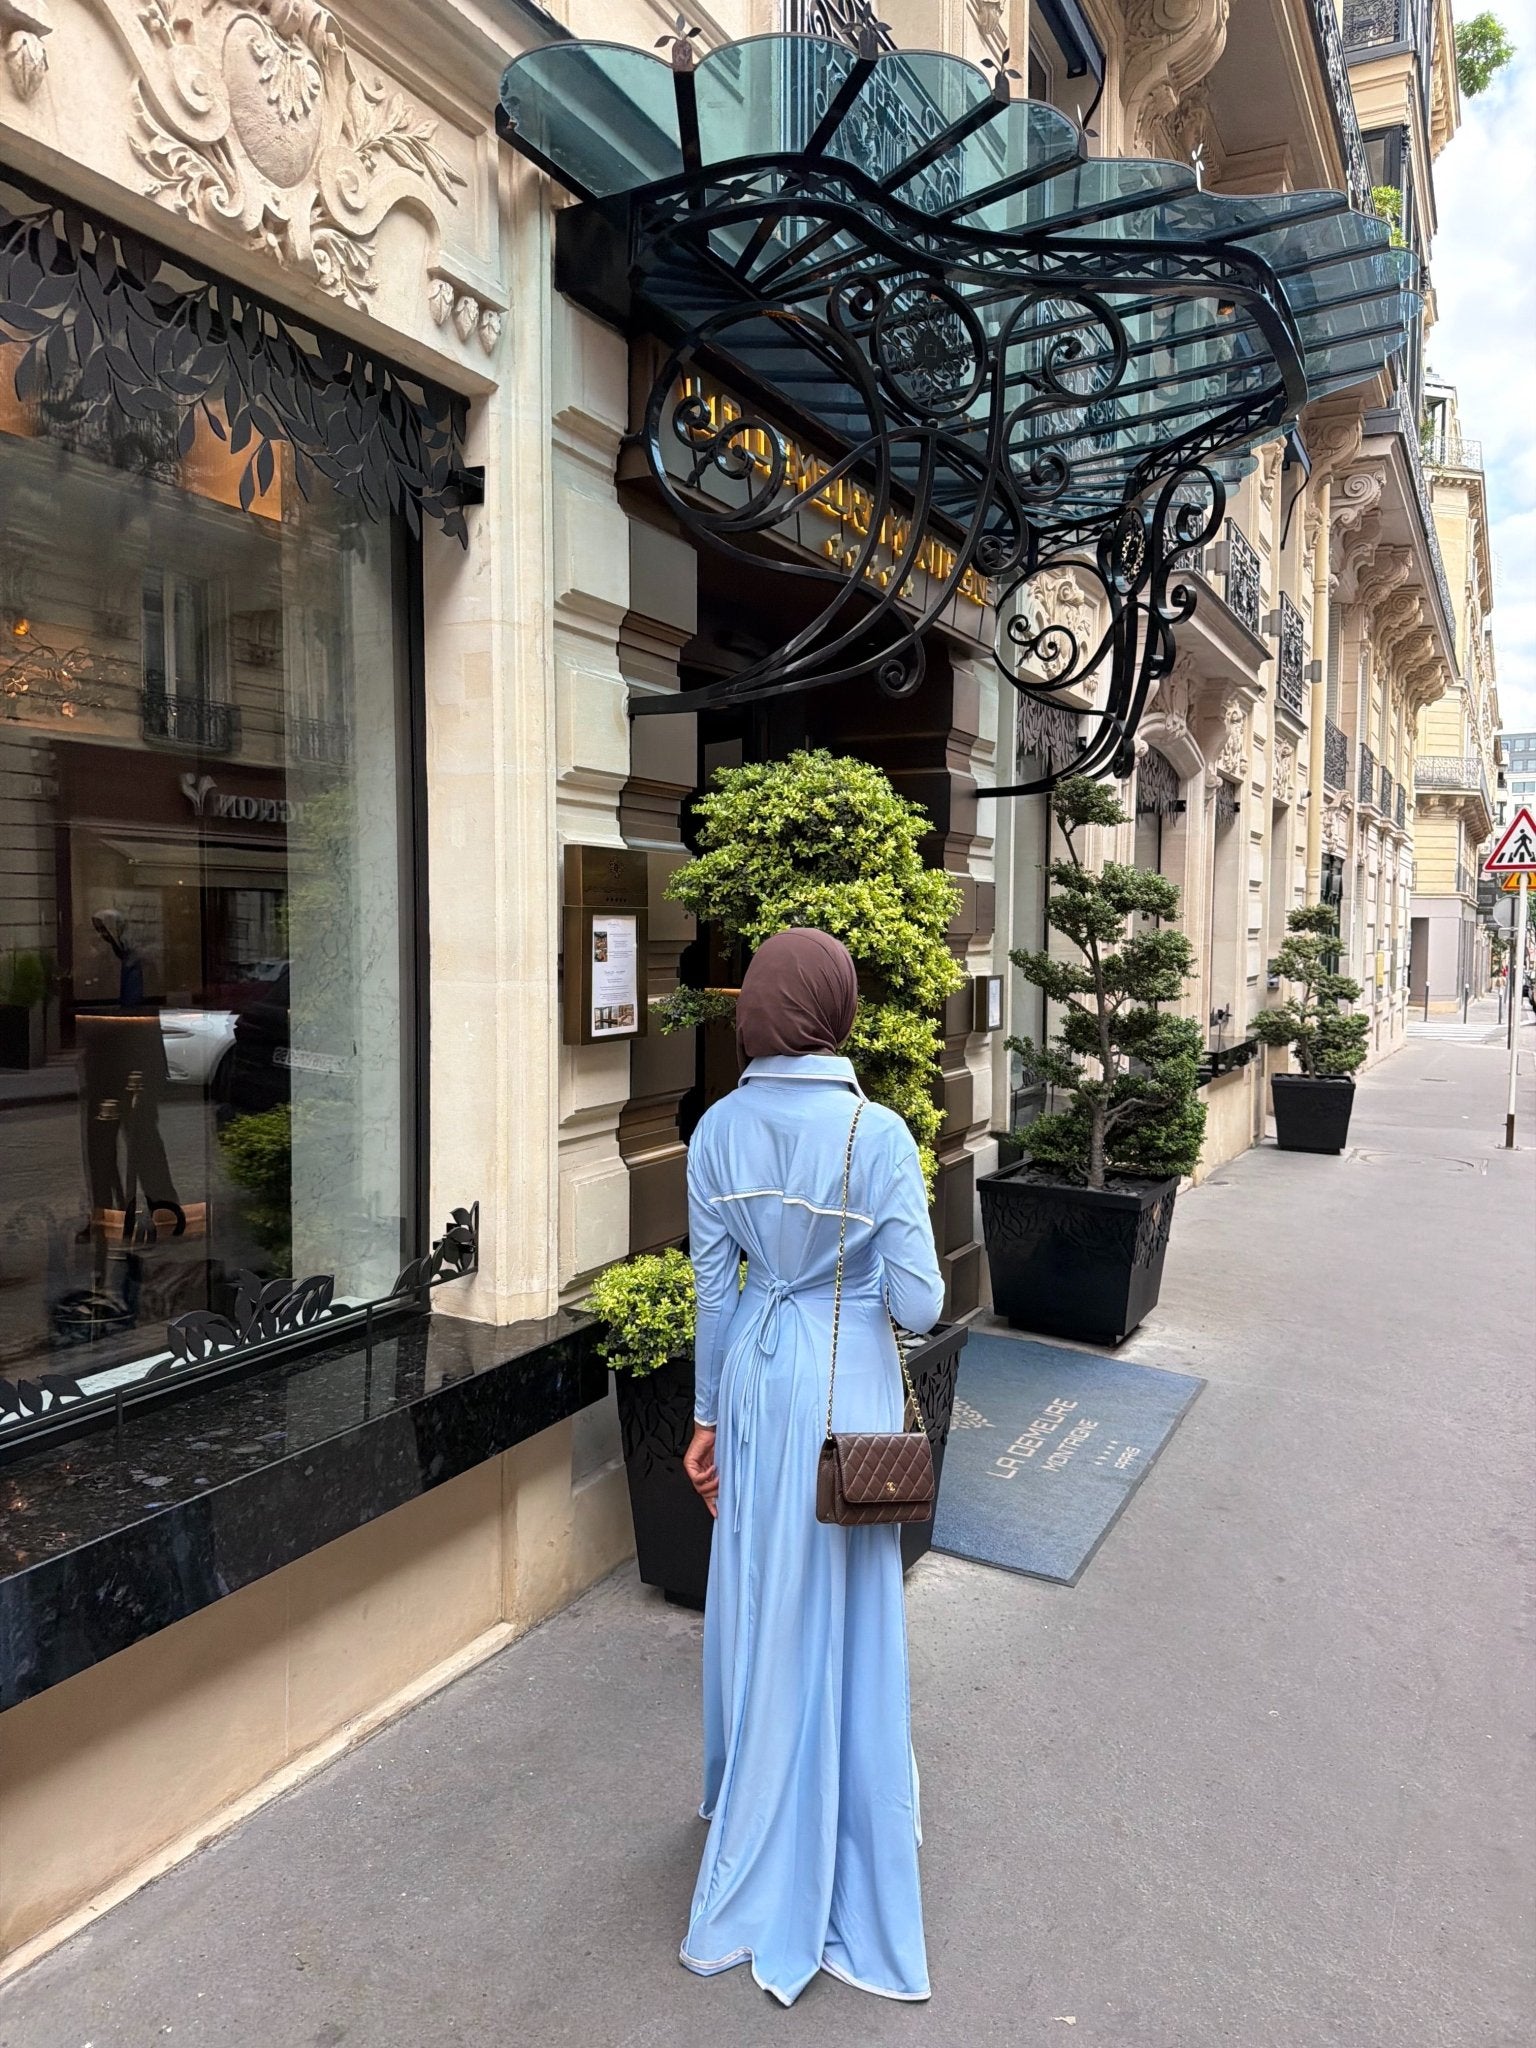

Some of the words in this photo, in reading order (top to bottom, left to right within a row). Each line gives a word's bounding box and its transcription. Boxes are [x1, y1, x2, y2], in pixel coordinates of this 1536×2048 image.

[986, 1456, 1025, 1479] LA
[1006, 1397, 1079, 1458] DEMEURE
[1041, 1417, 1099, 1472] MONTAIGNE
